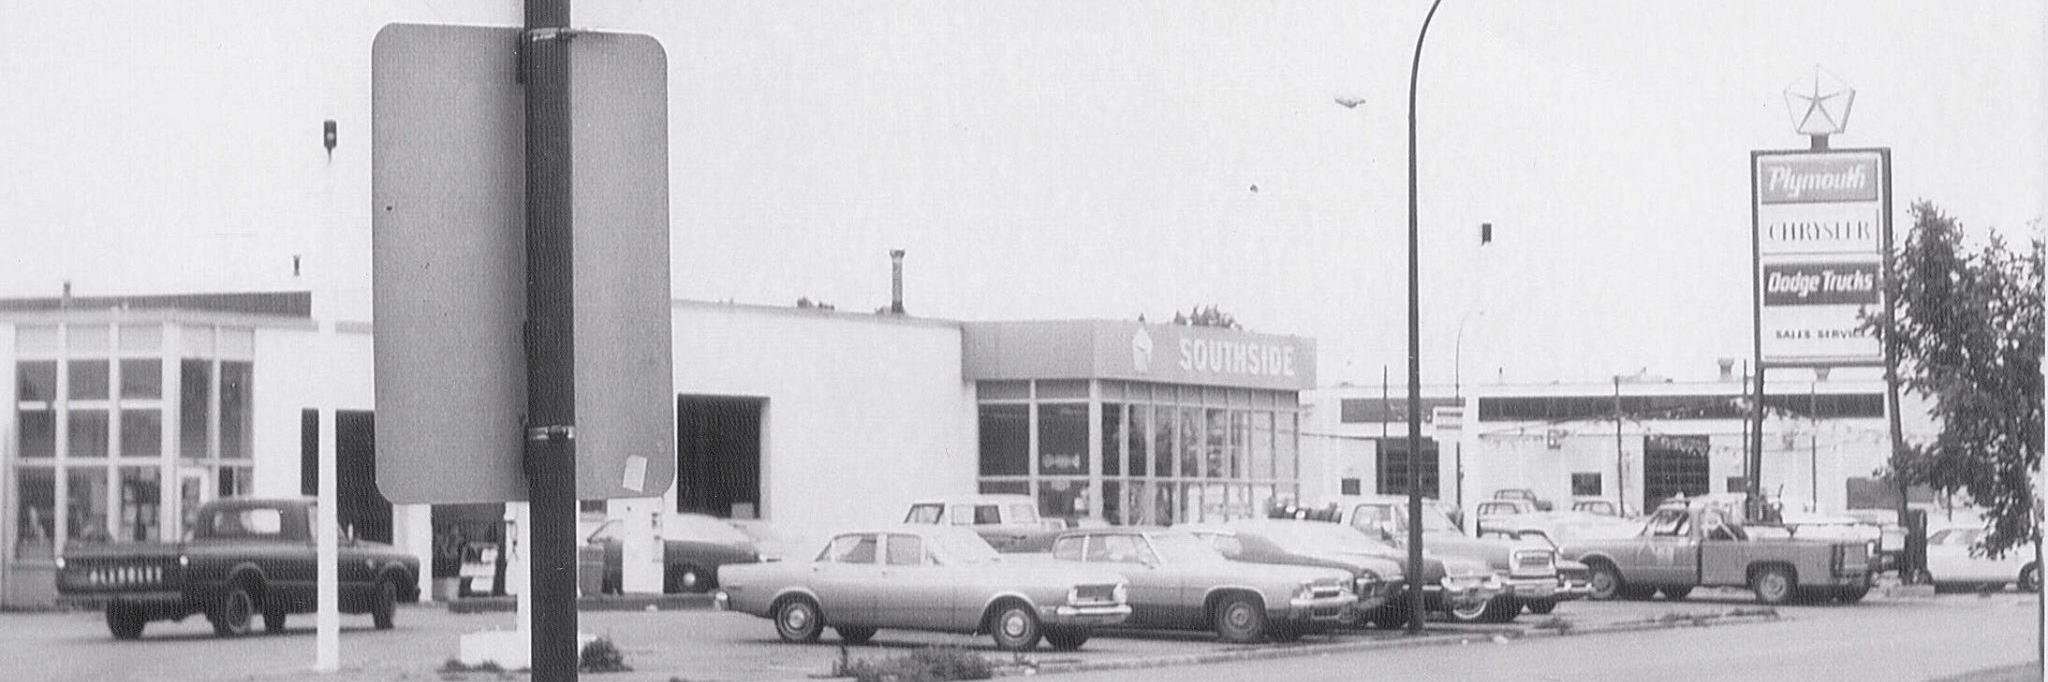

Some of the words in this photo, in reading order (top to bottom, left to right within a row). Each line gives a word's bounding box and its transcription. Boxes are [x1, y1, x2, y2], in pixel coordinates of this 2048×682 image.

[1768, 163, 1867, 199] Plymouth
[1769, 220, 1871, 241] CHRYSLER
[1768, 270, 1819, 298] Dodge
[1822, 269, 1873, 292] Trucks
[1775, 329, 1811, 340] SALES
[1178, 337, 1296, 377] SOUTHSIDE
